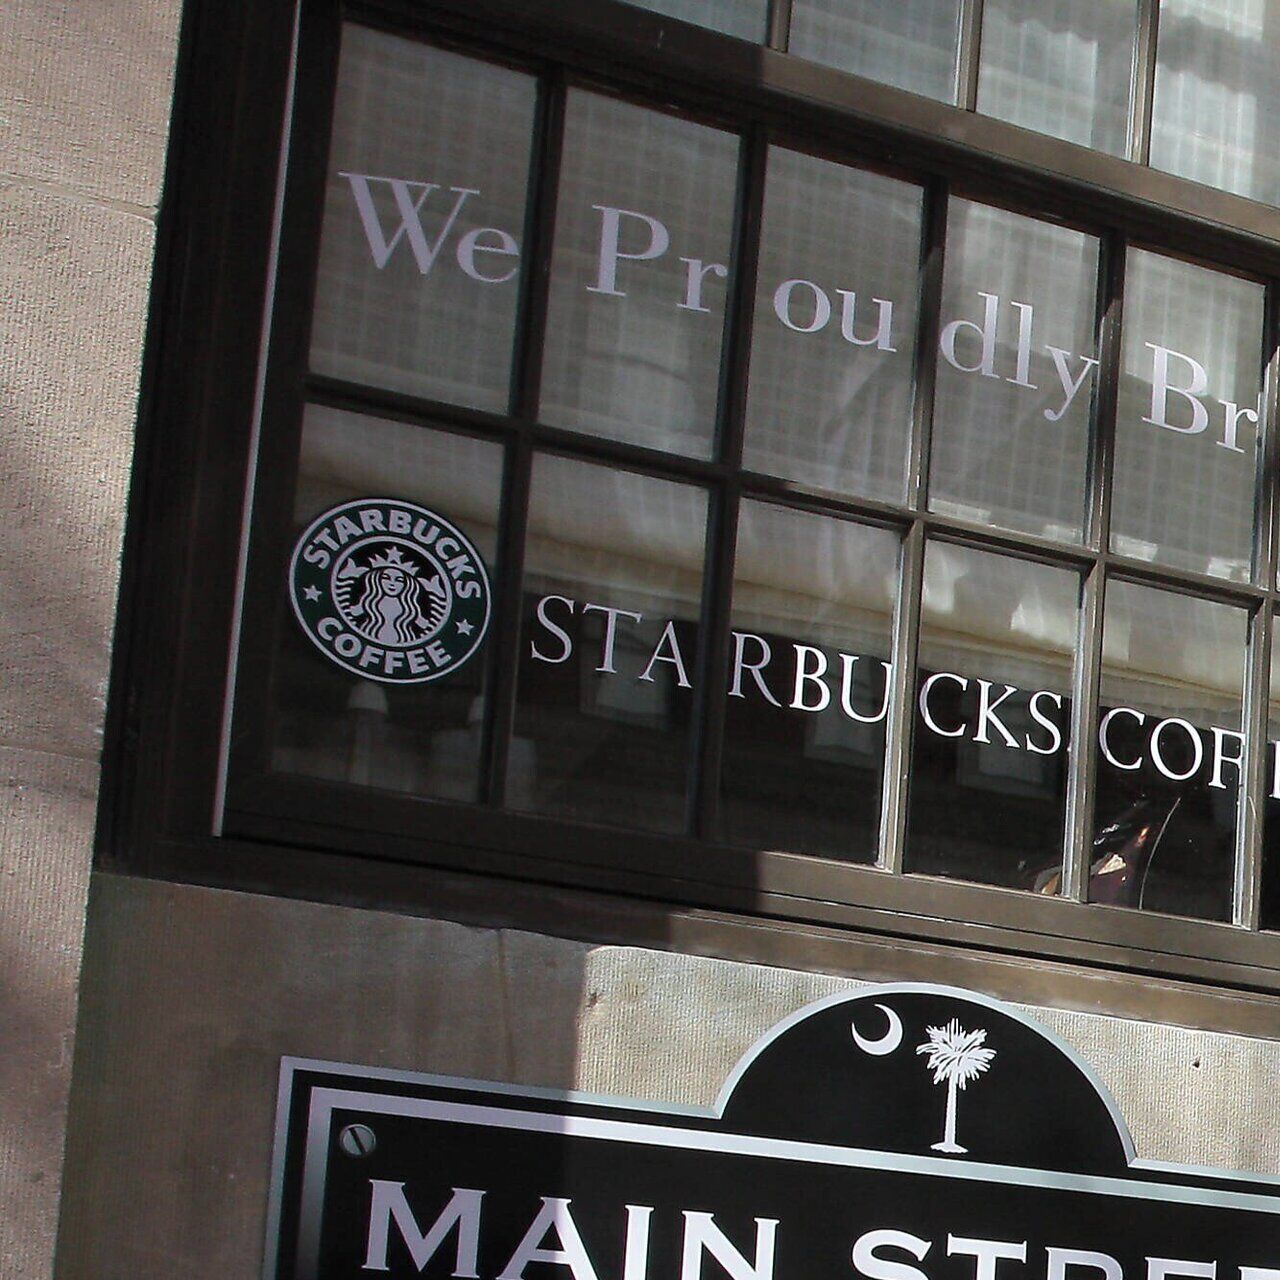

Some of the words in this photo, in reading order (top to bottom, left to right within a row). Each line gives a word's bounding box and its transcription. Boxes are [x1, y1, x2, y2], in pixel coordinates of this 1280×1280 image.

[337, 171, 520, 284] We
[585, 204, 1099, 422] Proudly
[303, 508, 482, 599] STARBUCKS
[317, 617, 452, 674] COFFEE
[531, 595, 1062, 755] STARBUCKS
